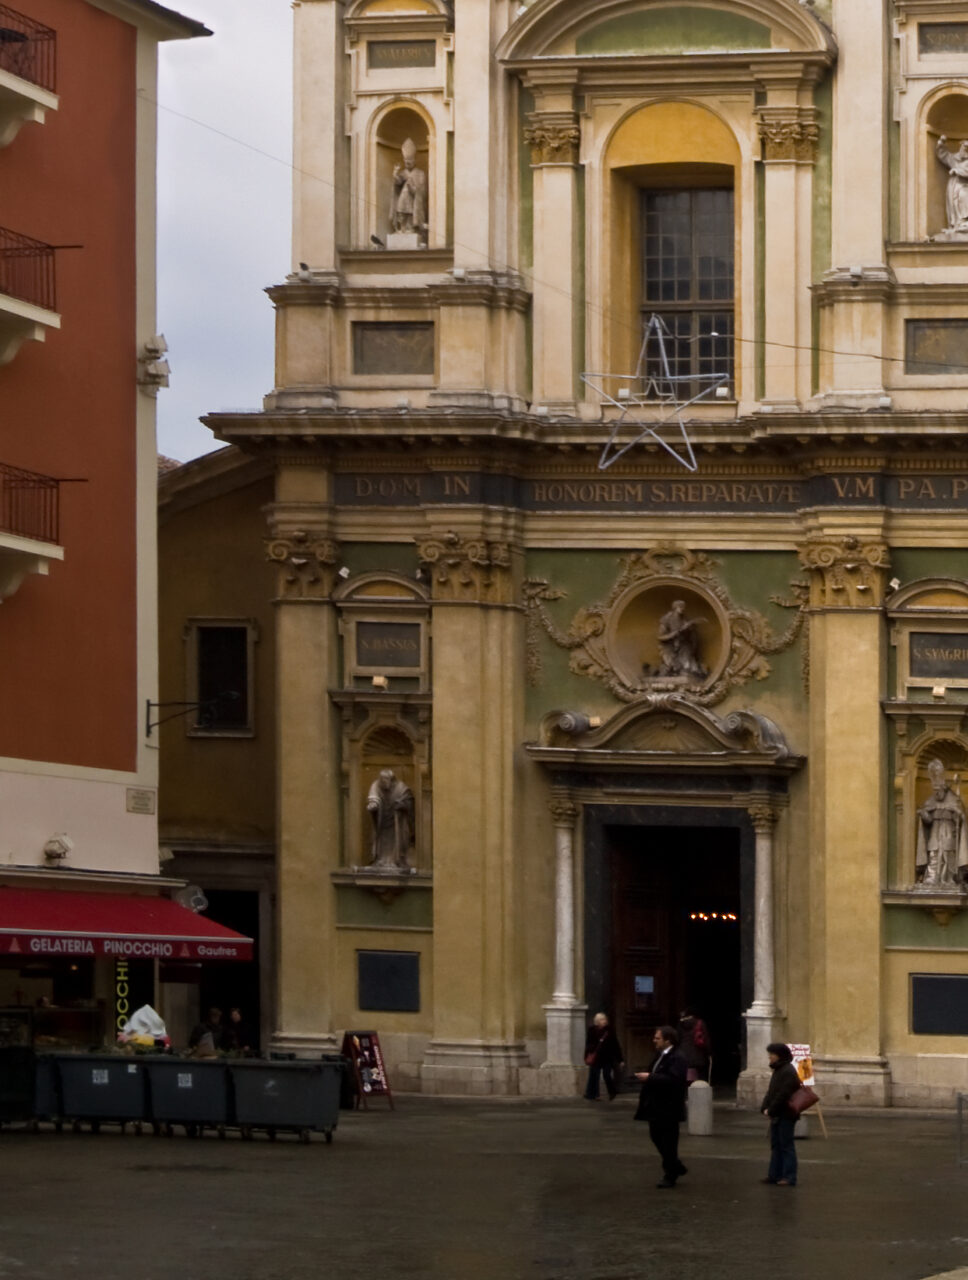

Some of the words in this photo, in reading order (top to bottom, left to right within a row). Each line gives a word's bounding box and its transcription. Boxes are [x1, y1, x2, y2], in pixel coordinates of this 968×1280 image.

[443, 475, 471, 496] IN
[535, 482, 643, 502] HONOREM
[30, 938, 94, 954] GELATERIA
[103, 940, 173, 957] PINOCCHIO
[197, 945, 237, 957] Gaufres
